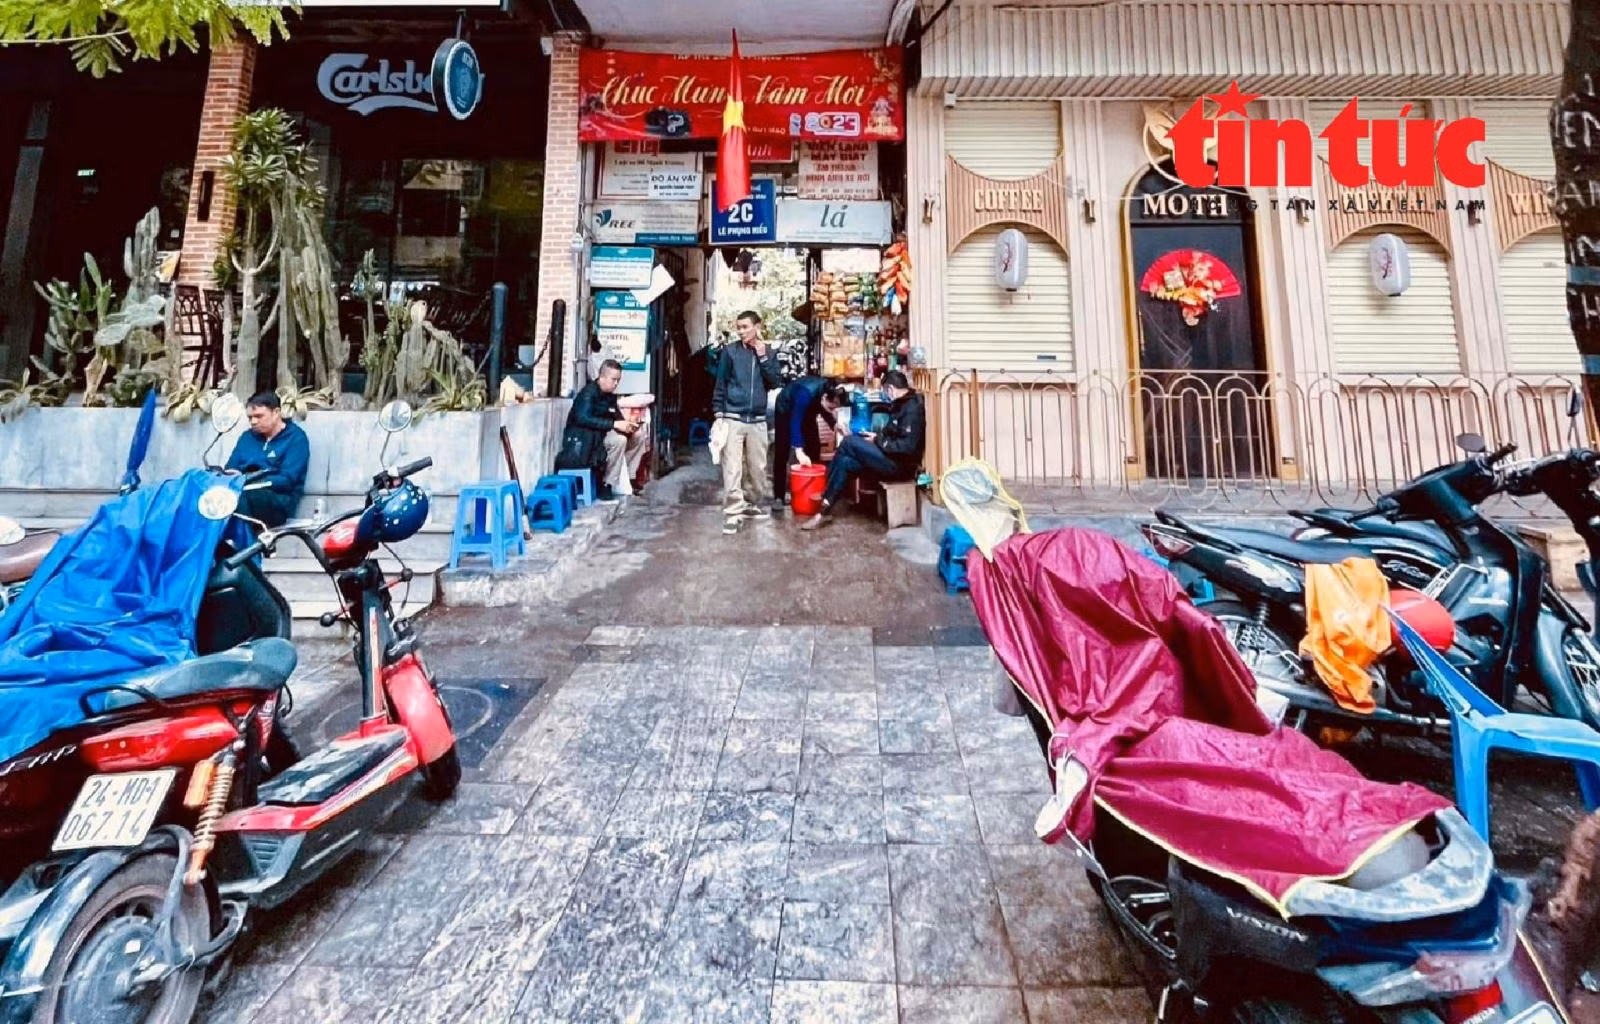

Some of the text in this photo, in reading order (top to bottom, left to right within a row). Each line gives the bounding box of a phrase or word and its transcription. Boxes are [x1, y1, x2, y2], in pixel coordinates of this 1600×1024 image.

[974, 188, 1044, 212] COFFEE
[1143, 192, 1229, 217] MOTH
[727, 203, 754, 223] 2C
[1226, 906, 1309, 943] VISION
